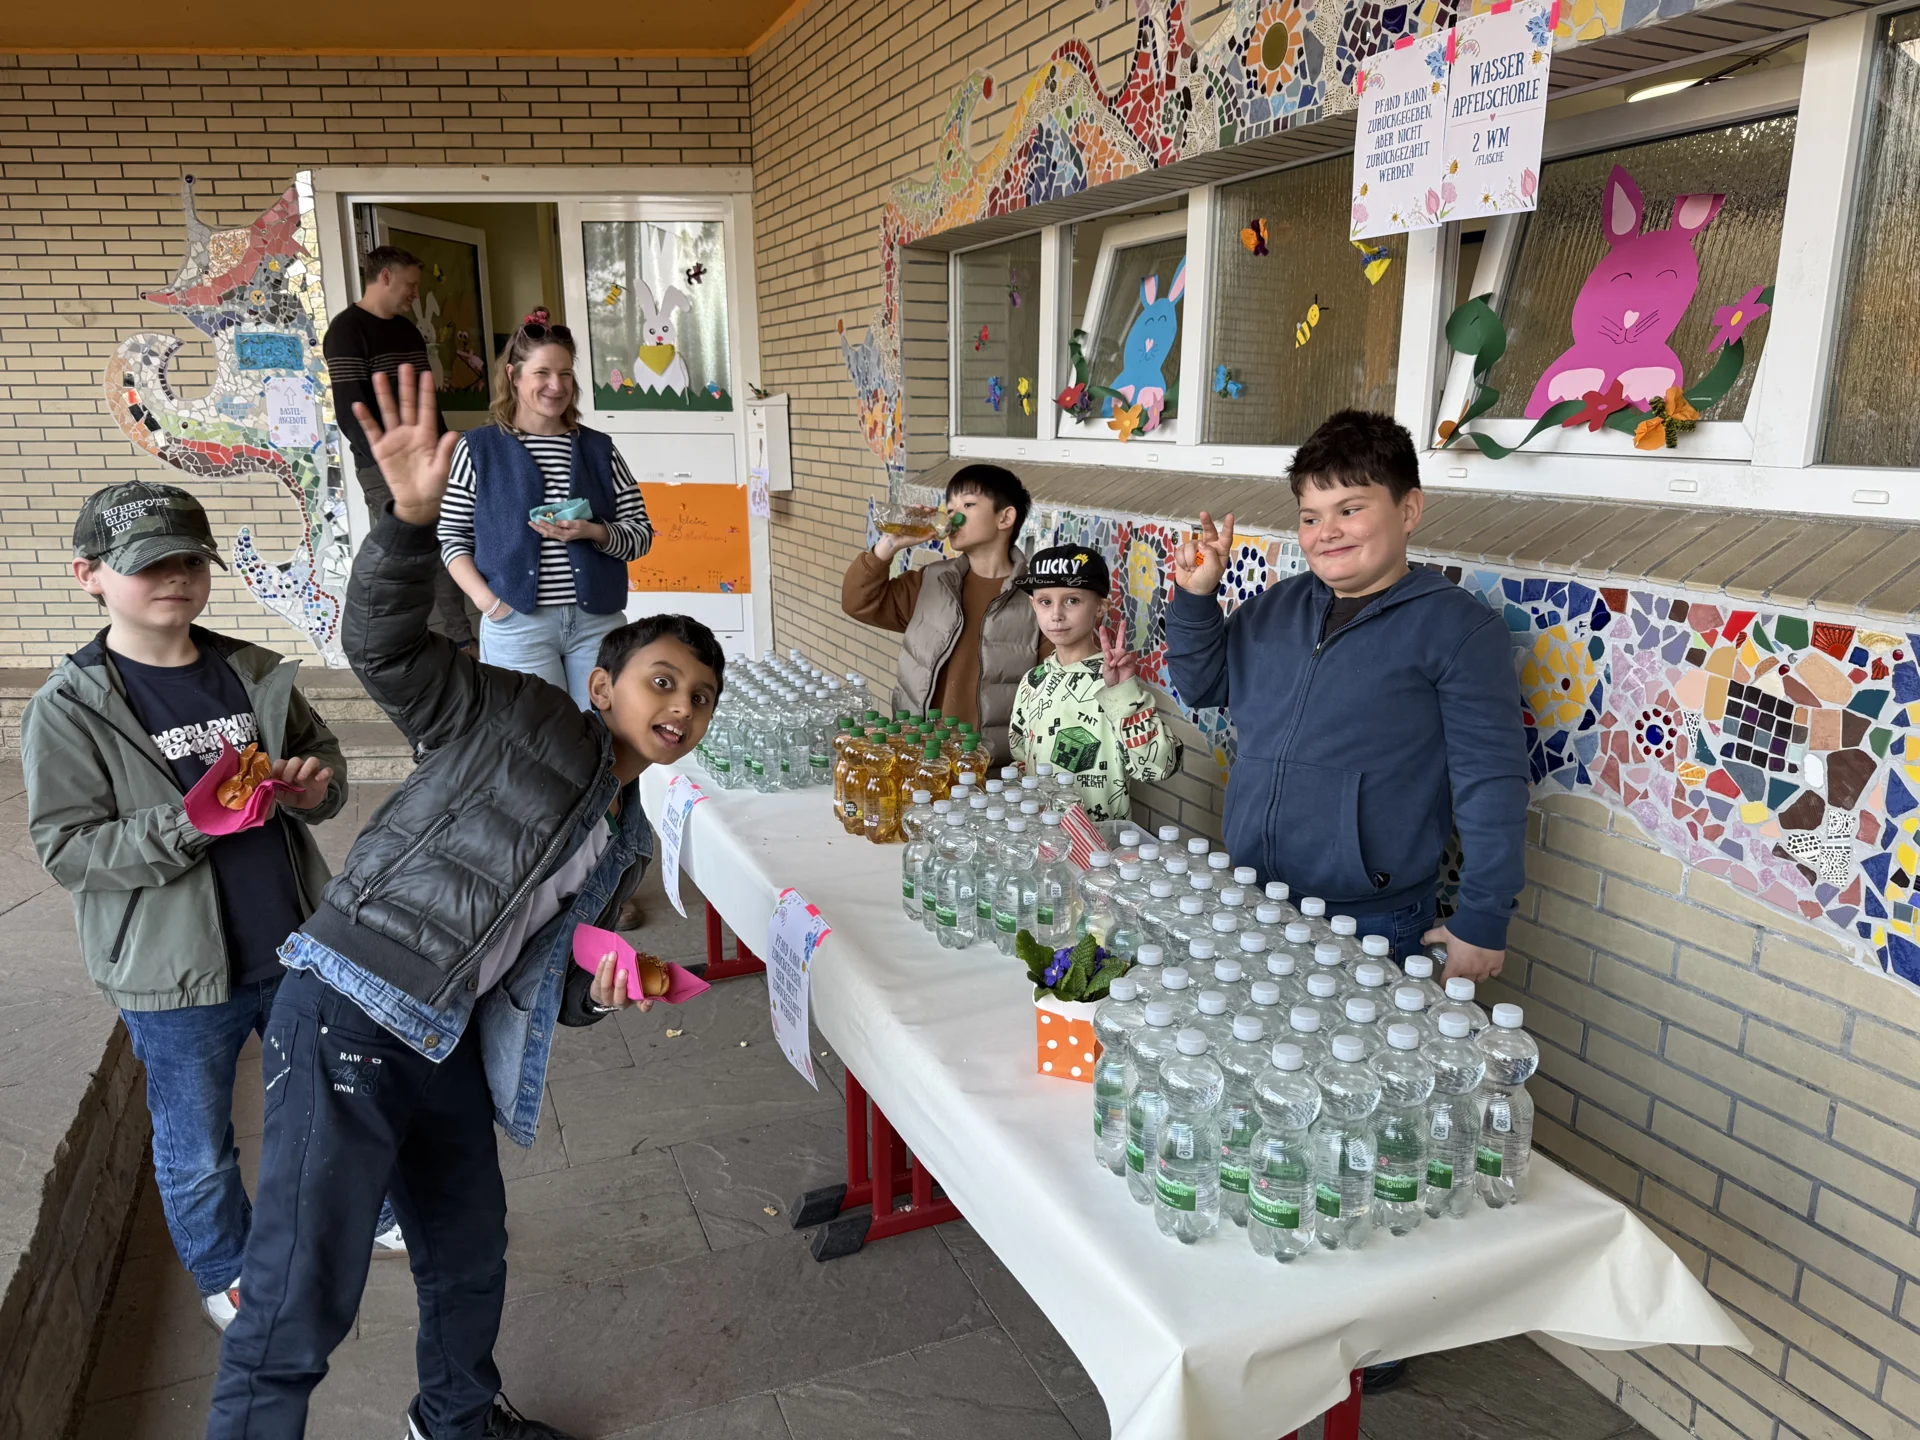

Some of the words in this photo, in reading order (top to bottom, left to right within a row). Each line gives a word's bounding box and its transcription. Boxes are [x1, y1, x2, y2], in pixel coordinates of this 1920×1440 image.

[1470, 52, 1525, 87] WASSER
[1374, 94, 1400, 114] PFAND
[1404, 86, 1428, 106] KANN
[1452, 78, 1540, 118] APFELSCHORLE
[1367, 103, 1432, 134] ZURÜCKGEGEBEN,
[1375, 130, 1394, 150] ABER
[1397, 125, 1422, 145] NICHT
[1472, 132, 1480, 153] 2
[1487, 126, 1510, 150] WM
[1366, 141, 1430, 169] ZURÜCKGEZAHLT
[1379, 162, 1414, 183] WERDEN!
[102, 497, 170, 519] RUHRPOTT
[110, 520, 133, 537] AUF
[1036, 558, 1080, 574] LUCKY
[1077, 711, 1098, 726] TNT
[1122, 719, 1151, 738] TNT
[340, 1052, 362, 1063] RAW
[334, 1083, 354, 1094] DNM
[1266, 1204, 1292, 1215] Quelle
